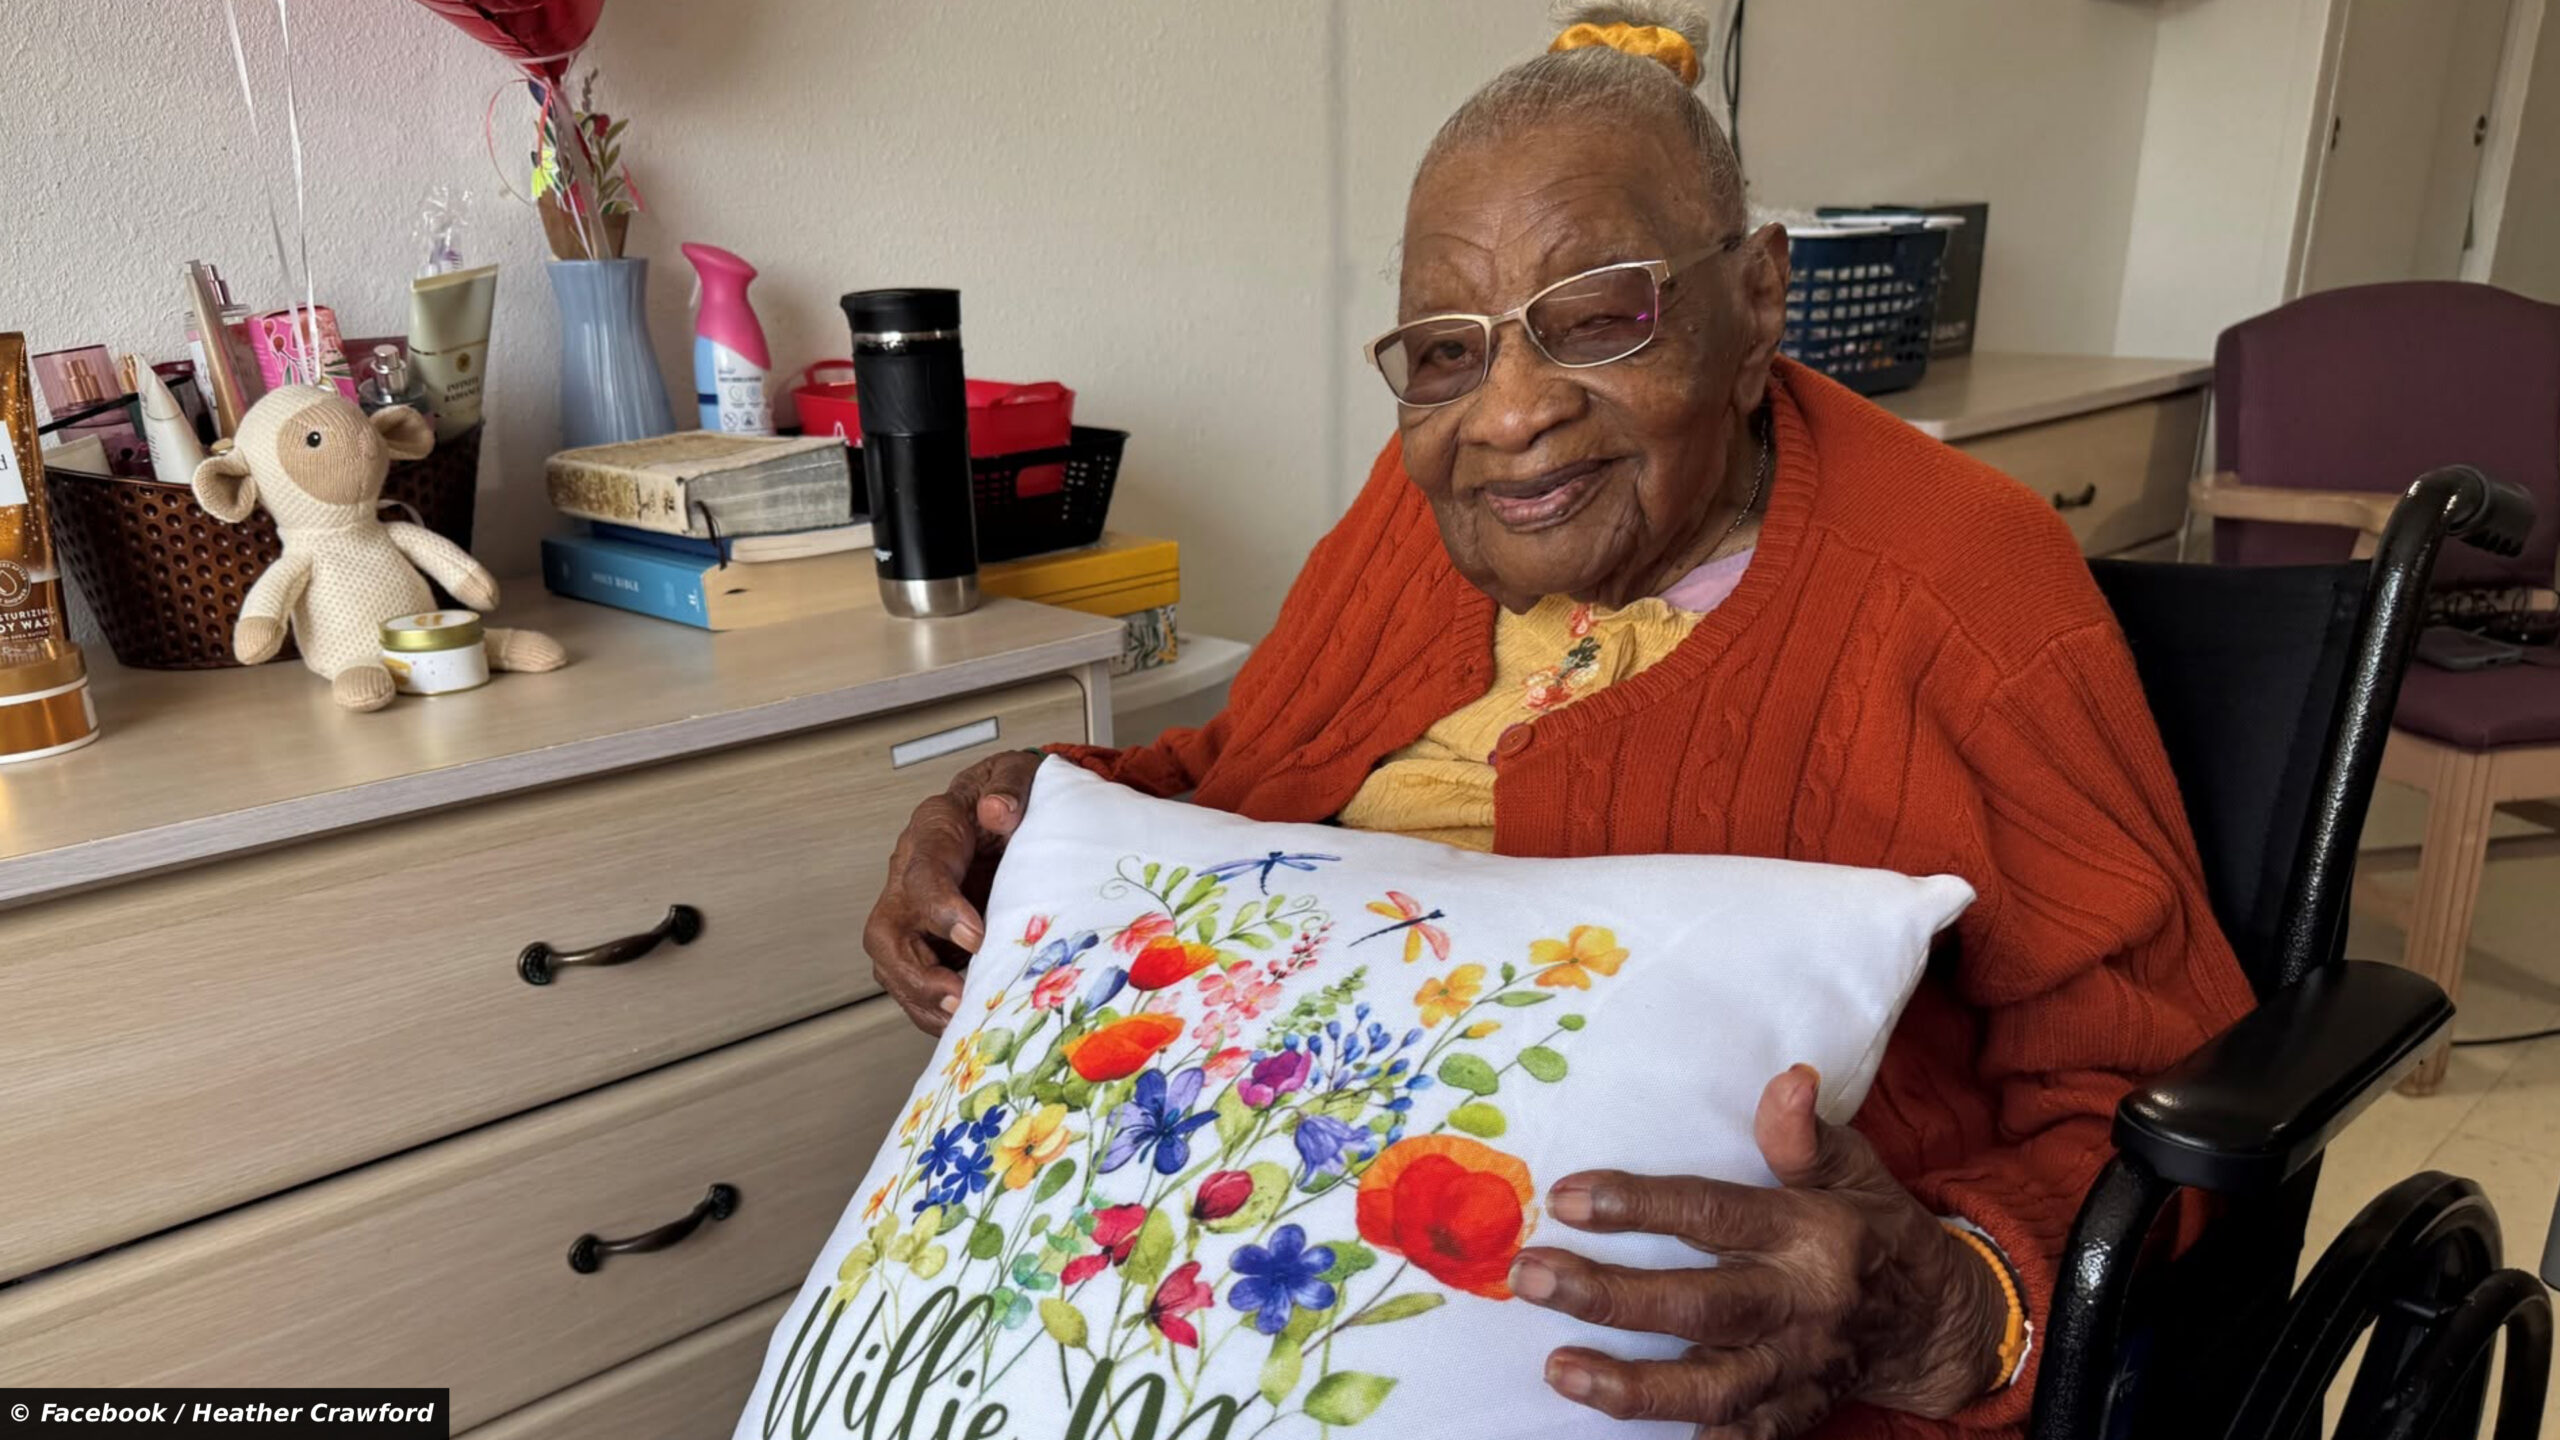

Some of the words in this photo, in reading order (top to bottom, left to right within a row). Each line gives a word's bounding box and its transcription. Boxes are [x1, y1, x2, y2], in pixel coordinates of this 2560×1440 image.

[615, 577, 640, 592] BIBLE
[0, 622, 15, 634] DY
[20, 615, 58, 630] WASH
[762, 1284, 1012, 1440] Willie
